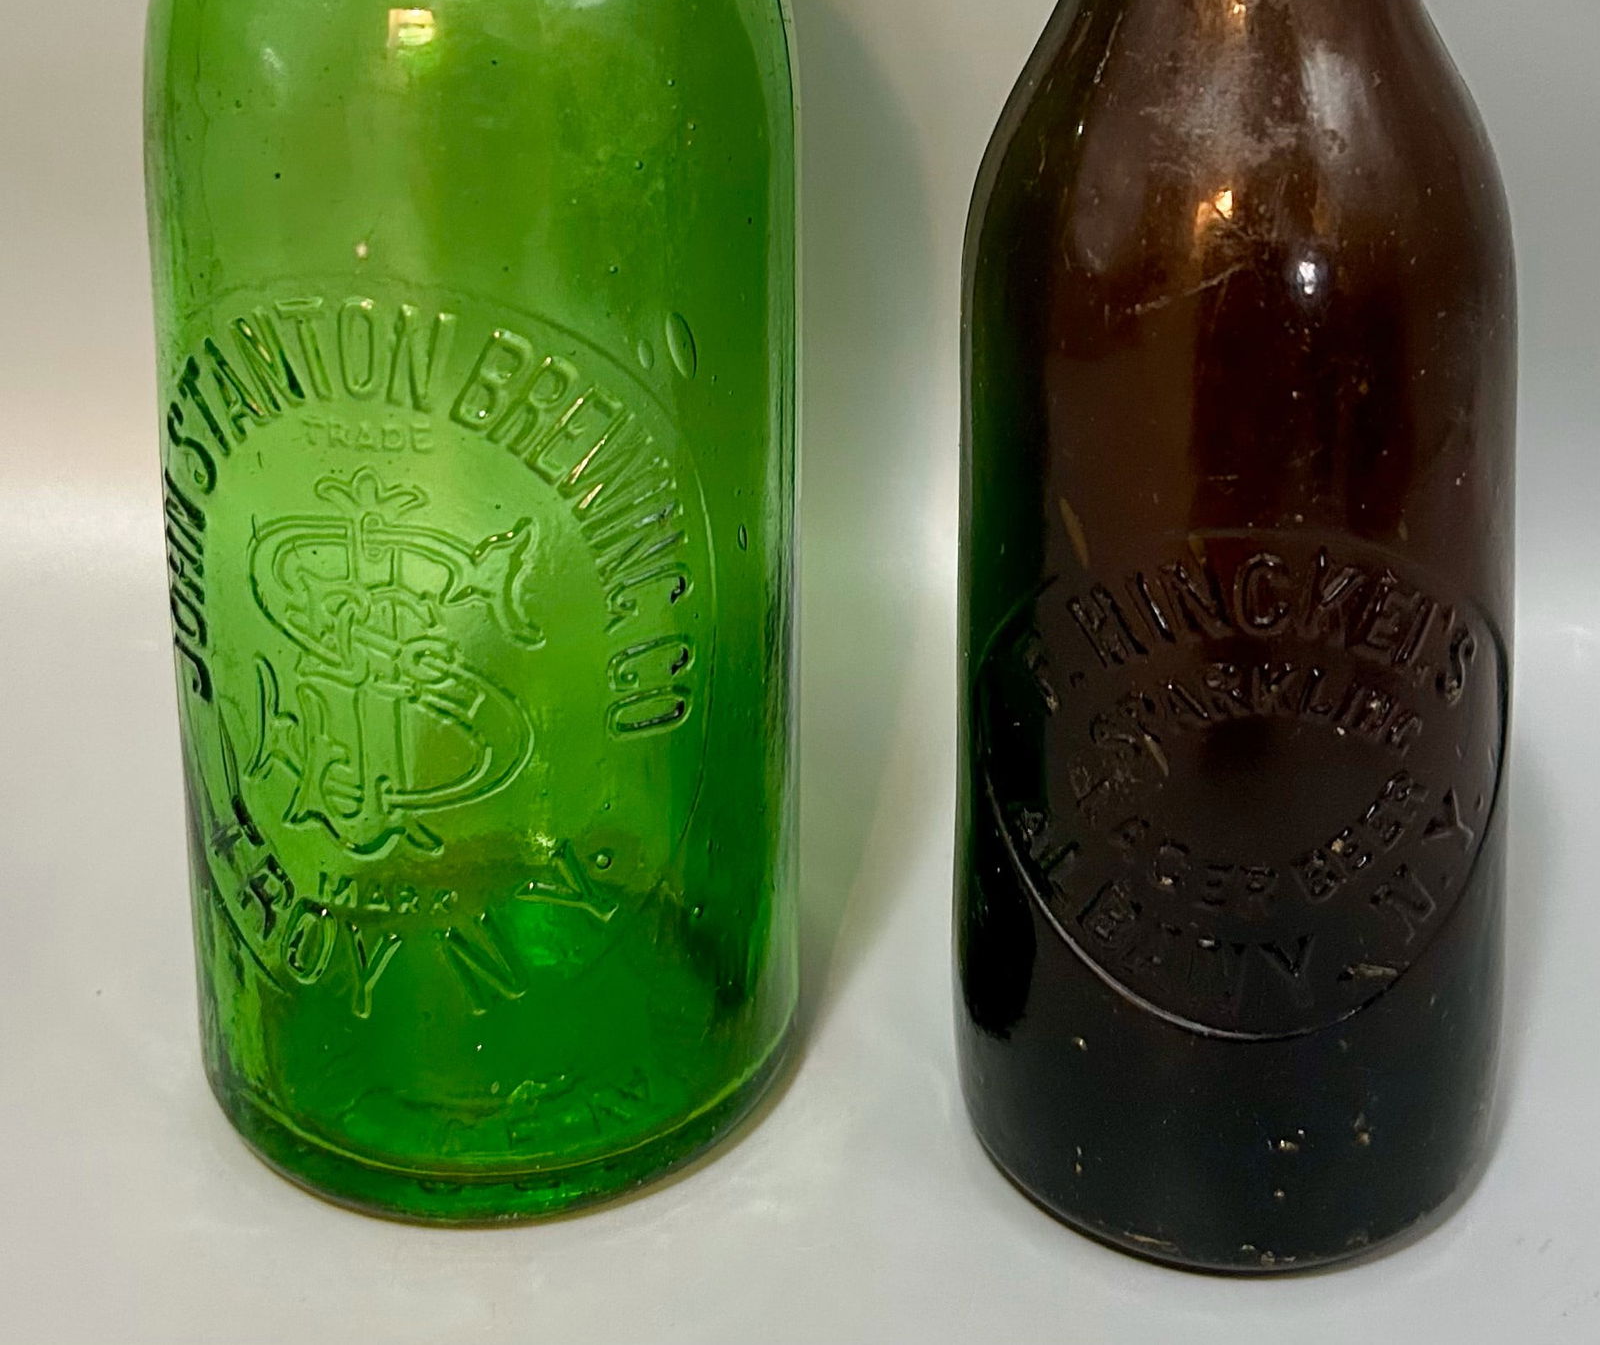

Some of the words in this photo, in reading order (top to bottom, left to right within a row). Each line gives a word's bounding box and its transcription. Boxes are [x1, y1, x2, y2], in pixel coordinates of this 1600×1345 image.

[167, 296, 456, 496] STANTON
[302, 416, 434, 452] TRADE
[449, 327, 695, 634] BREWING
[164, 466, 213, 704] JOHN
[606, 633, 696, 740] CO
[207, 794, 402, 1020] TROY
[316, 871, 459, 914] MARK
